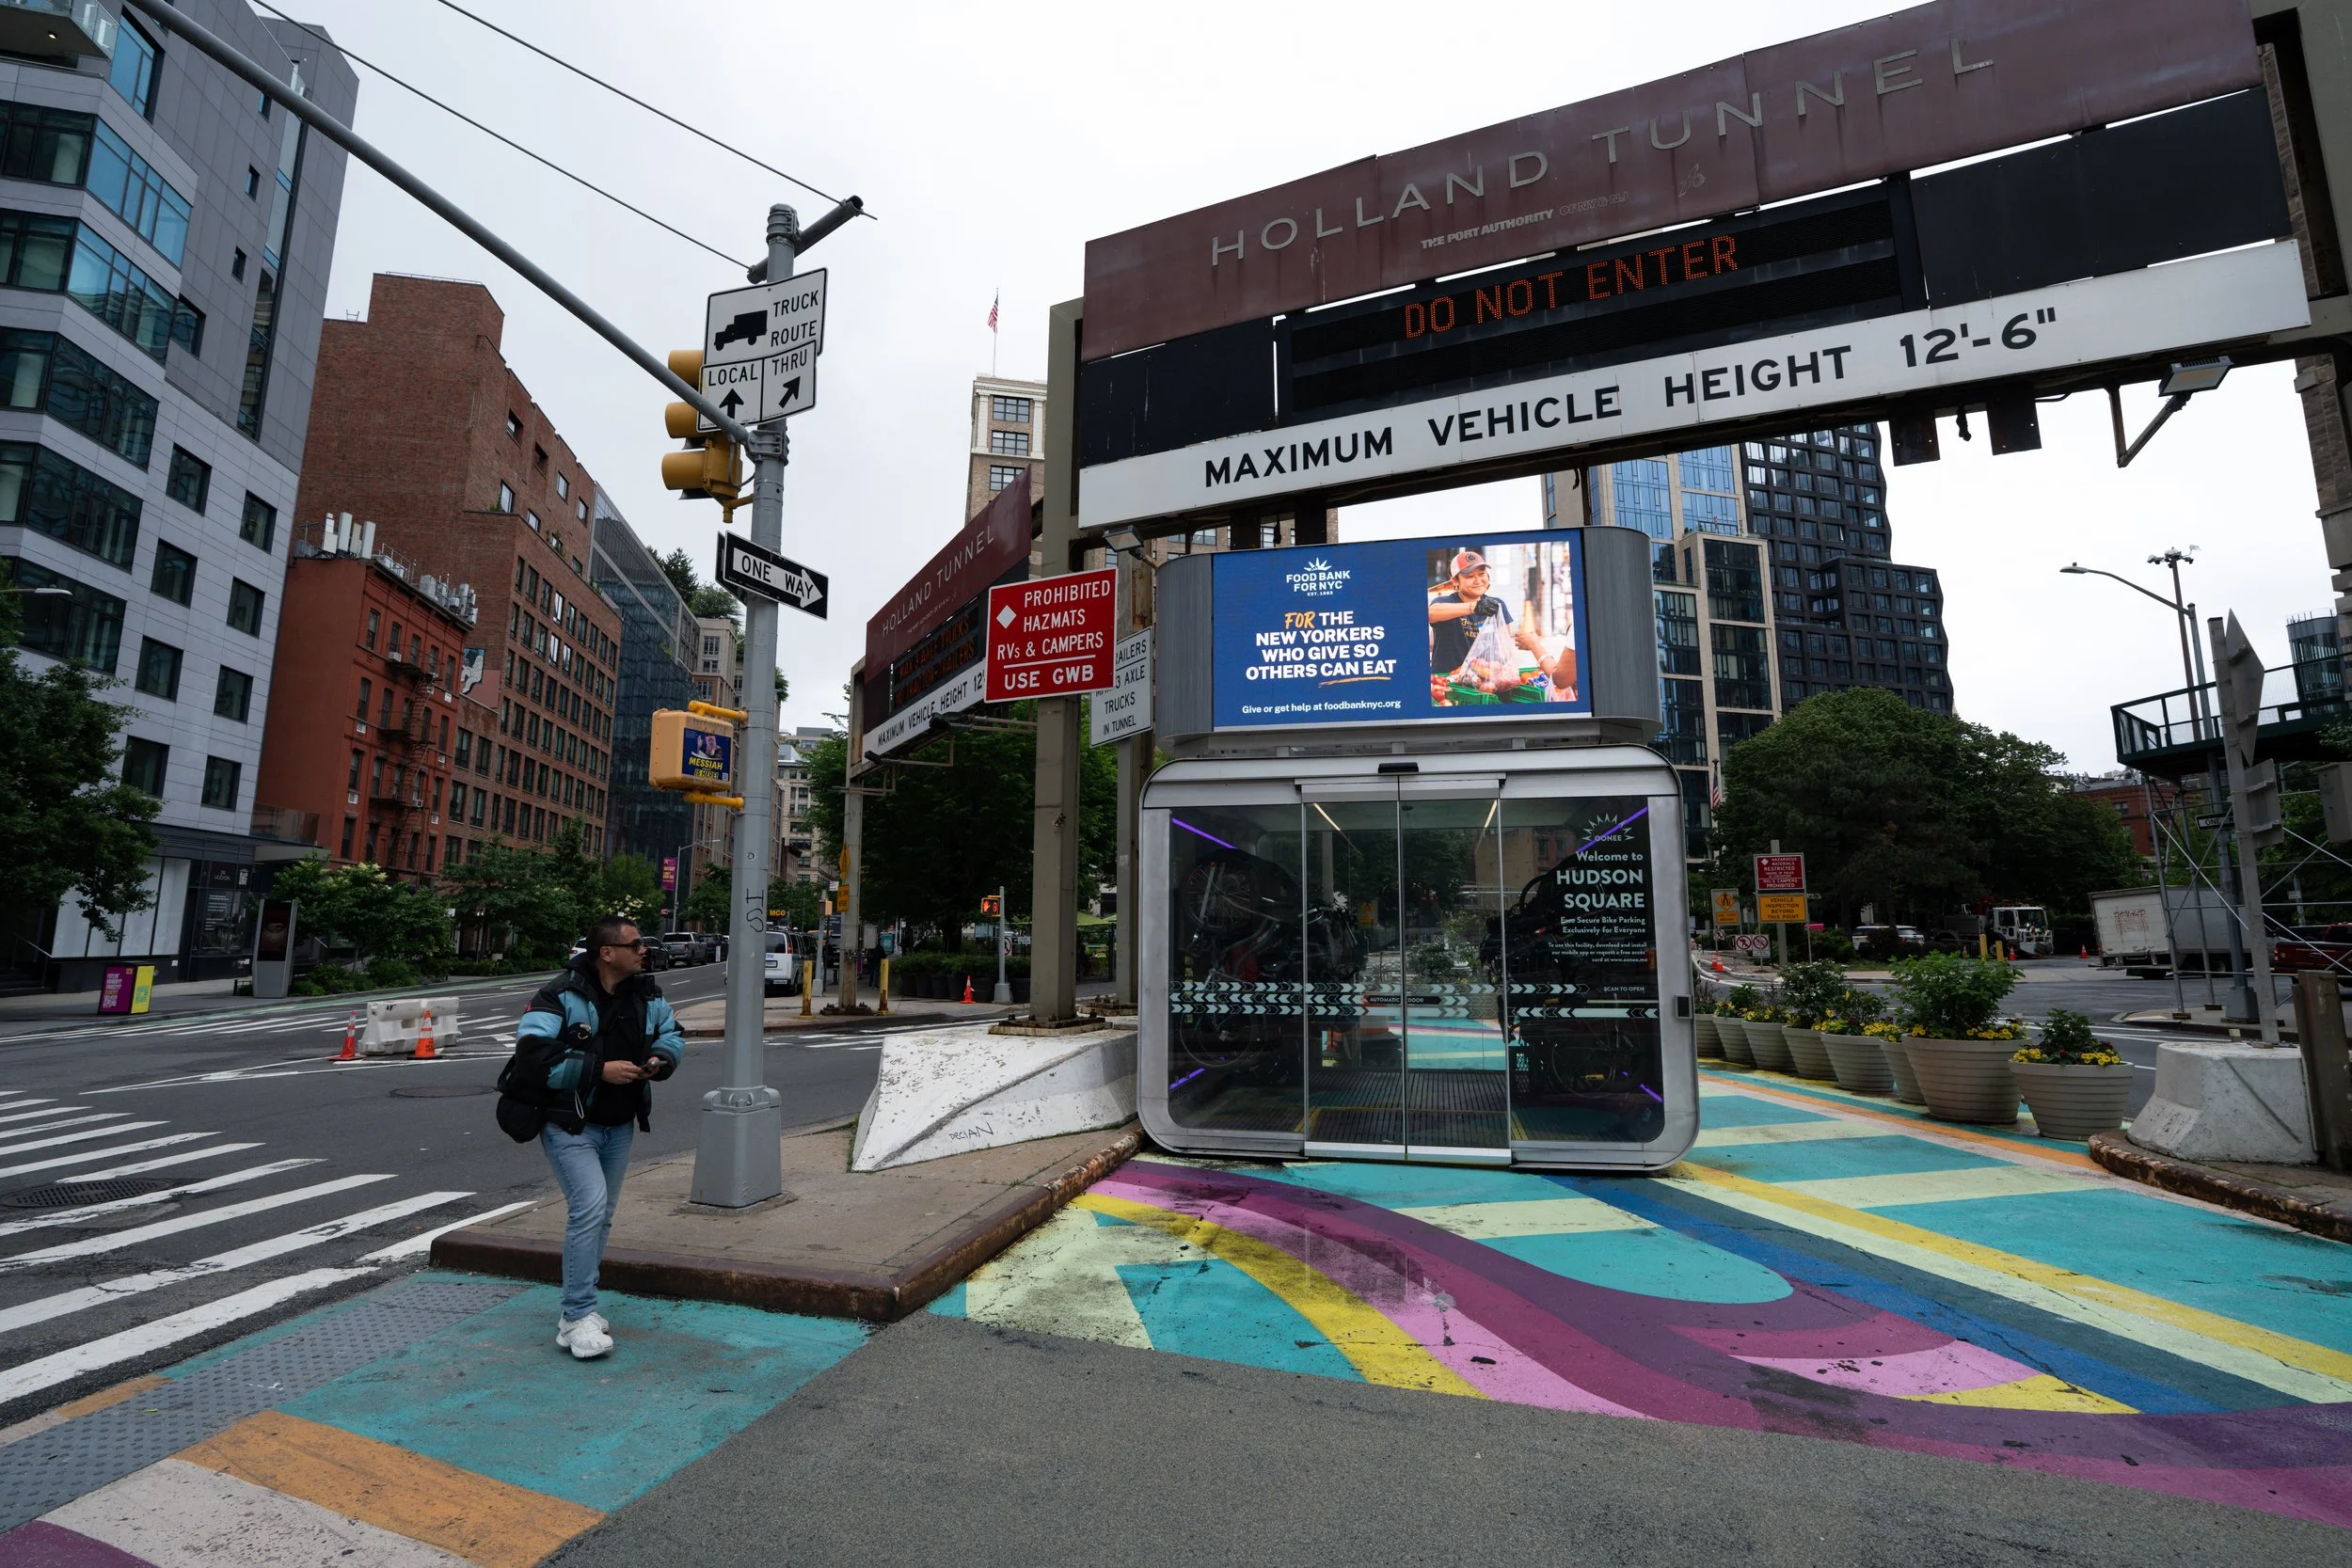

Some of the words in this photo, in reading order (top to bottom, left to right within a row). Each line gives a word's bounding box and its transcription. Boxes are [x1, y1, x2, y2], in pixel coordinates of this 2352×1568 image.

[1212, 151, 1548, 266] HOLLAND
[1592, 38, 1994, 164] TUNNEL
[1421, 237, 1444, 249] THE
[1448, 226, 1479, 243] PORT
[1480, 209, 1554, 235] AUTHORITY
[1559, 203, 1577, 216] OF
[1578, 198, 1597, 213] NY
[1610, 191, 1629, 208] NJ
[1405, 295, 1455, 339] DO
[1476, 271, 1563, 324] NOT
[1586, 235, 1739, 301] ENTER
[773, 290, 818, 317] TRUCK
[771, 320, 817, 347] ROUTE
[771, 349, 807, 376] THRU
[708, 363, 758, 387] LOCAL
[1205, 426, 1392, 488] MAXIMUM
[1427, 386, 1622, 447] VEHICLE
[1664, 345, 1851, 407] HEIGHT
[1899, 307, 2057, 368] 12'-6"
[741, 555, 771, 583] ONE
[785, 573, 814, 599] WAY
[882, 581, 931, 638] HOLLAND
[936, 525, 994, 588] TUNNEL
[1286, 573, 1317, 583] FOOD
[1319, 570, 1351, 580] BANK
[1294, 582, 1317, 592] FOR
[1319, 580, 1343, 591] NYC
[1024, 580, 1110, 608] PROHIBITED
[1024, 609, 1086, 632] HAZMATS
[1284, 611, 1315, 629] FOR
[1319, 611, 1353, 626] THE
[997, 642, 1020, 660] RVs
[1025, 641, 1036, 657] &
[1042, 631, 1104, 655] CAMPERS
[1256, 631, 1296, 646] NEW
[1300, 626, 1385, 643] YORKERS
[1262, 647, 1304, 662] WHO
[1308, 645, 1350, 660] GIVE
[1353, 643, 1379, 657] SO
[1004, 671, 1040, 690] USE
[1053, 664, 1094, 685] GWB
[1116, 675, 1121, 689] 3
[1124, 665, 1145, 685] AXLE
[1246, 663, 1317, 680] OTHERS
[1320, 661, 1359, 676] CAN
[1363, 659, 1396, 674] EAT
[878, 720, 904, 747] MAXIMUM
[908, 701, 935, 729] VEHICLE
[941, 681, 967, 711] HEIGHT
[1104, 691, 1136, 715] TRUCKS
[1242, 705, 1262, 714] Give
[1274, 705, 1289, 714] get
[1291, 703, 1311, 713] help
[1324, 700, 1401, 711] foodbanknyc.org
[1103, 722, 1110, 736] IN
[1112, 715, 1136, 732] TUNNEL
[689, 756, 723, 770] MESSIAH
[1576, 850, 1629, 862] Welcome
[1631, 852, 1644, 861] to
[1557, 869, 1644, 885] HUDSON
[1564, 893, 1645, 912] SQUARE
[1563, 927, 1599, 936] Exclusively
[1614, 927, 1645, 935] Everyone
[1619, 916, 1645, 926] Parking
